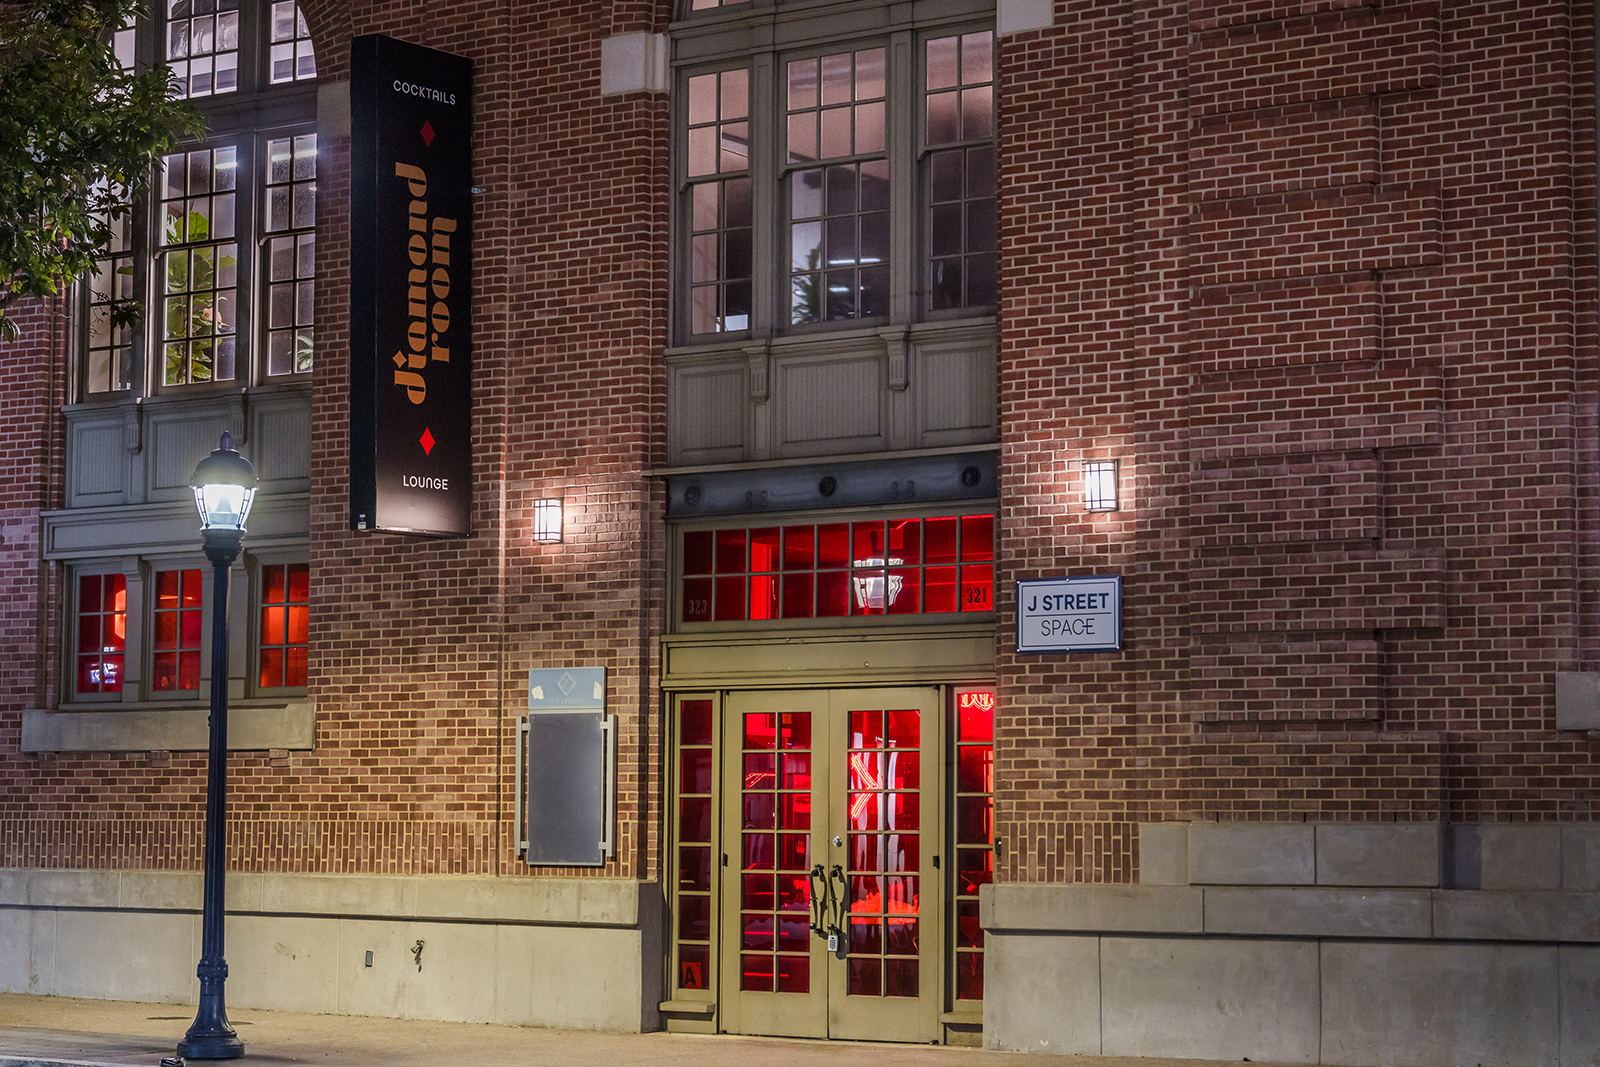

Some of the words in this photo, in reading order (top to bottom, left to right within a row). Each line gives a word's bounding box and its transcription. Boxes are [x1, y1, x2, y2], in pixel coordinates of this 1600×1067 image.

[393, 79, 456, 106] COCKTAILS
[393, 162, 428, 405] diamond
[431, 217, 457, 363] room
[402, 474, 449, 491] LOUNGE
[966, 588, 986, 603] 321
[1027, 595, 1037, 612] J
[1042, 592, 1109, 611] STREET
[689, 599, 707, 614] 323
[1041, 618, 1095, 636] SPACE
[684, 966, 697, 986] A
